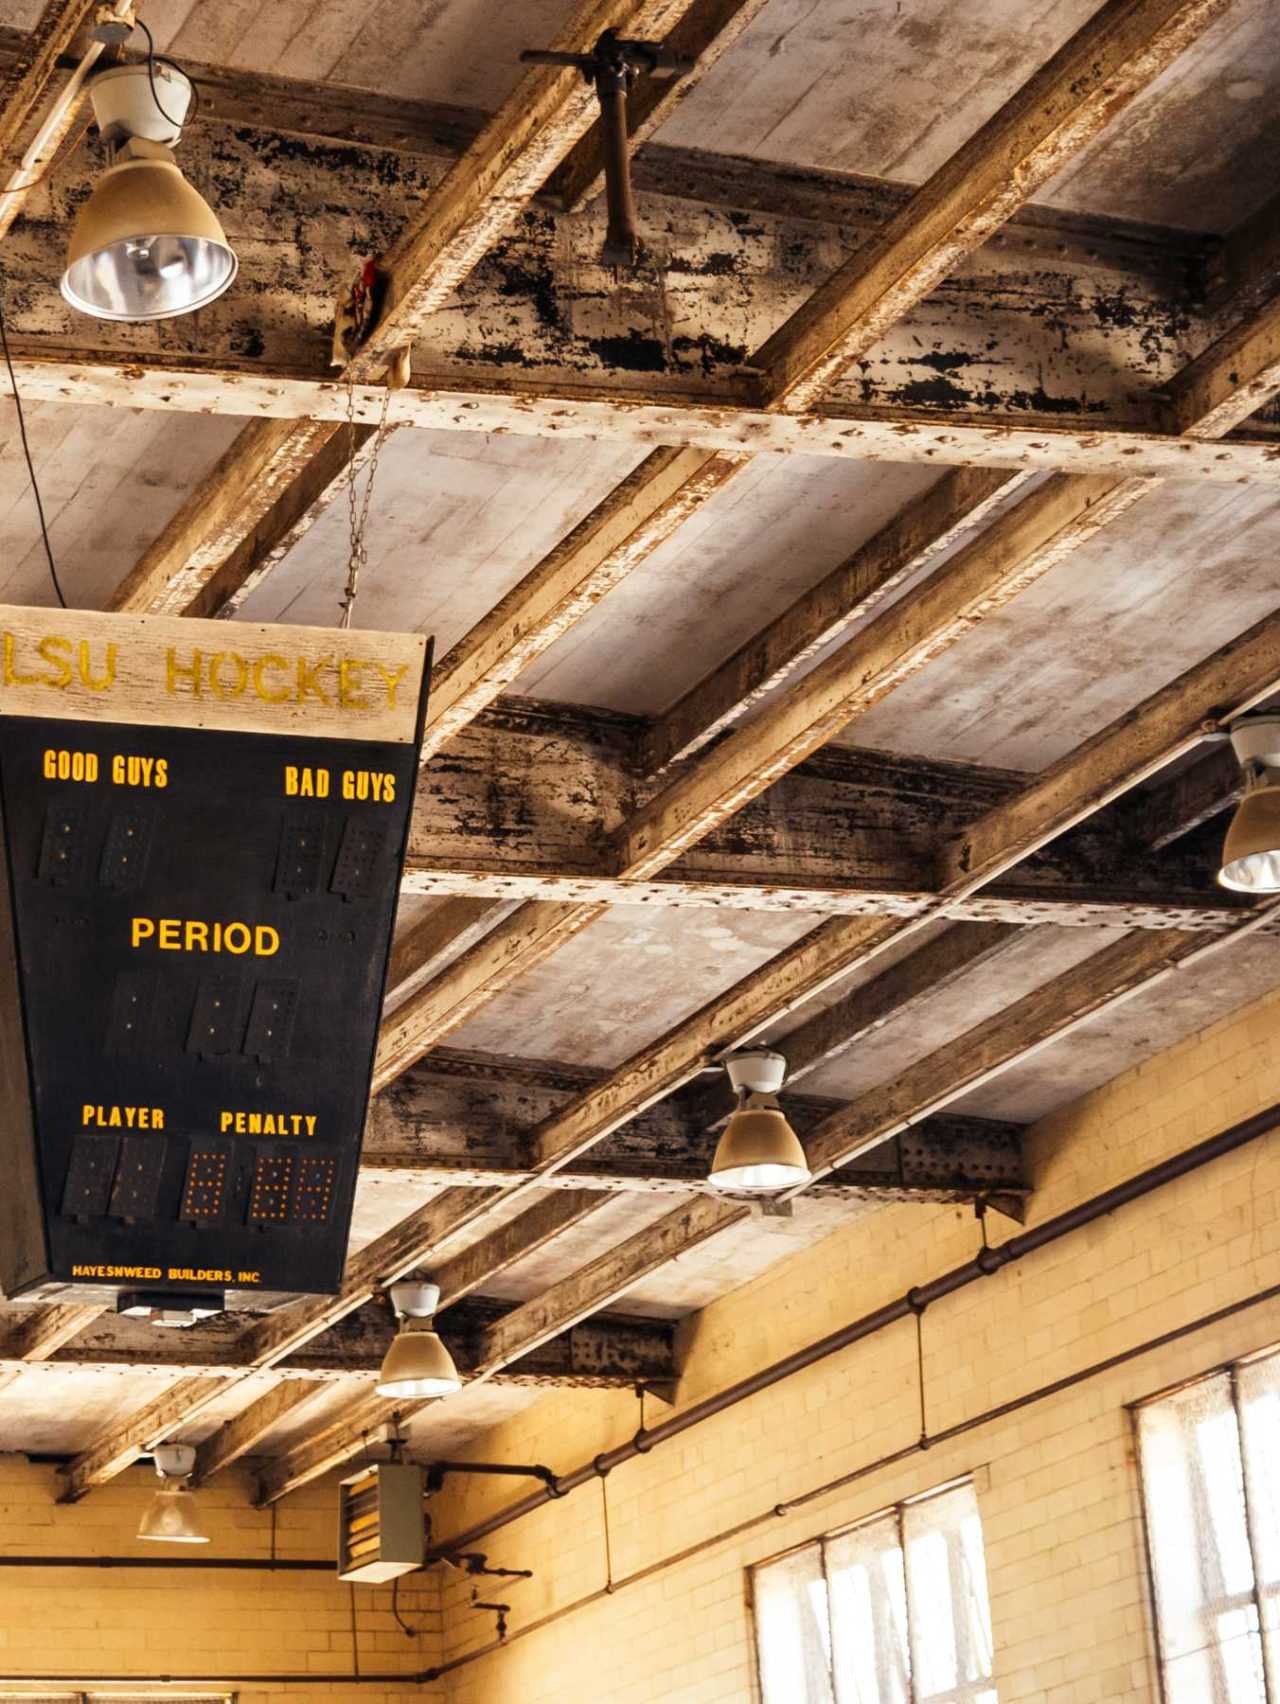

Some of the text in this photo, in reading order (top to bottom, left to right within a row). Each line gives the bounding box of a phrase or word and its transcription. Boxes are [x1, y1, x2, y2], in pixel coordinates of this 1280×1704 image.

[2, 632, 410, 712] LSU HOCKEY
[43, 750, 168, 787] GOOD GUYS
[285, 766, 396, 802] BAD GUYS
[131, 917, 280, 956] PERIOD
[82, 1105, 164, 1129] PLAYER
[220, 1112, 317, 1136] PENALTY
